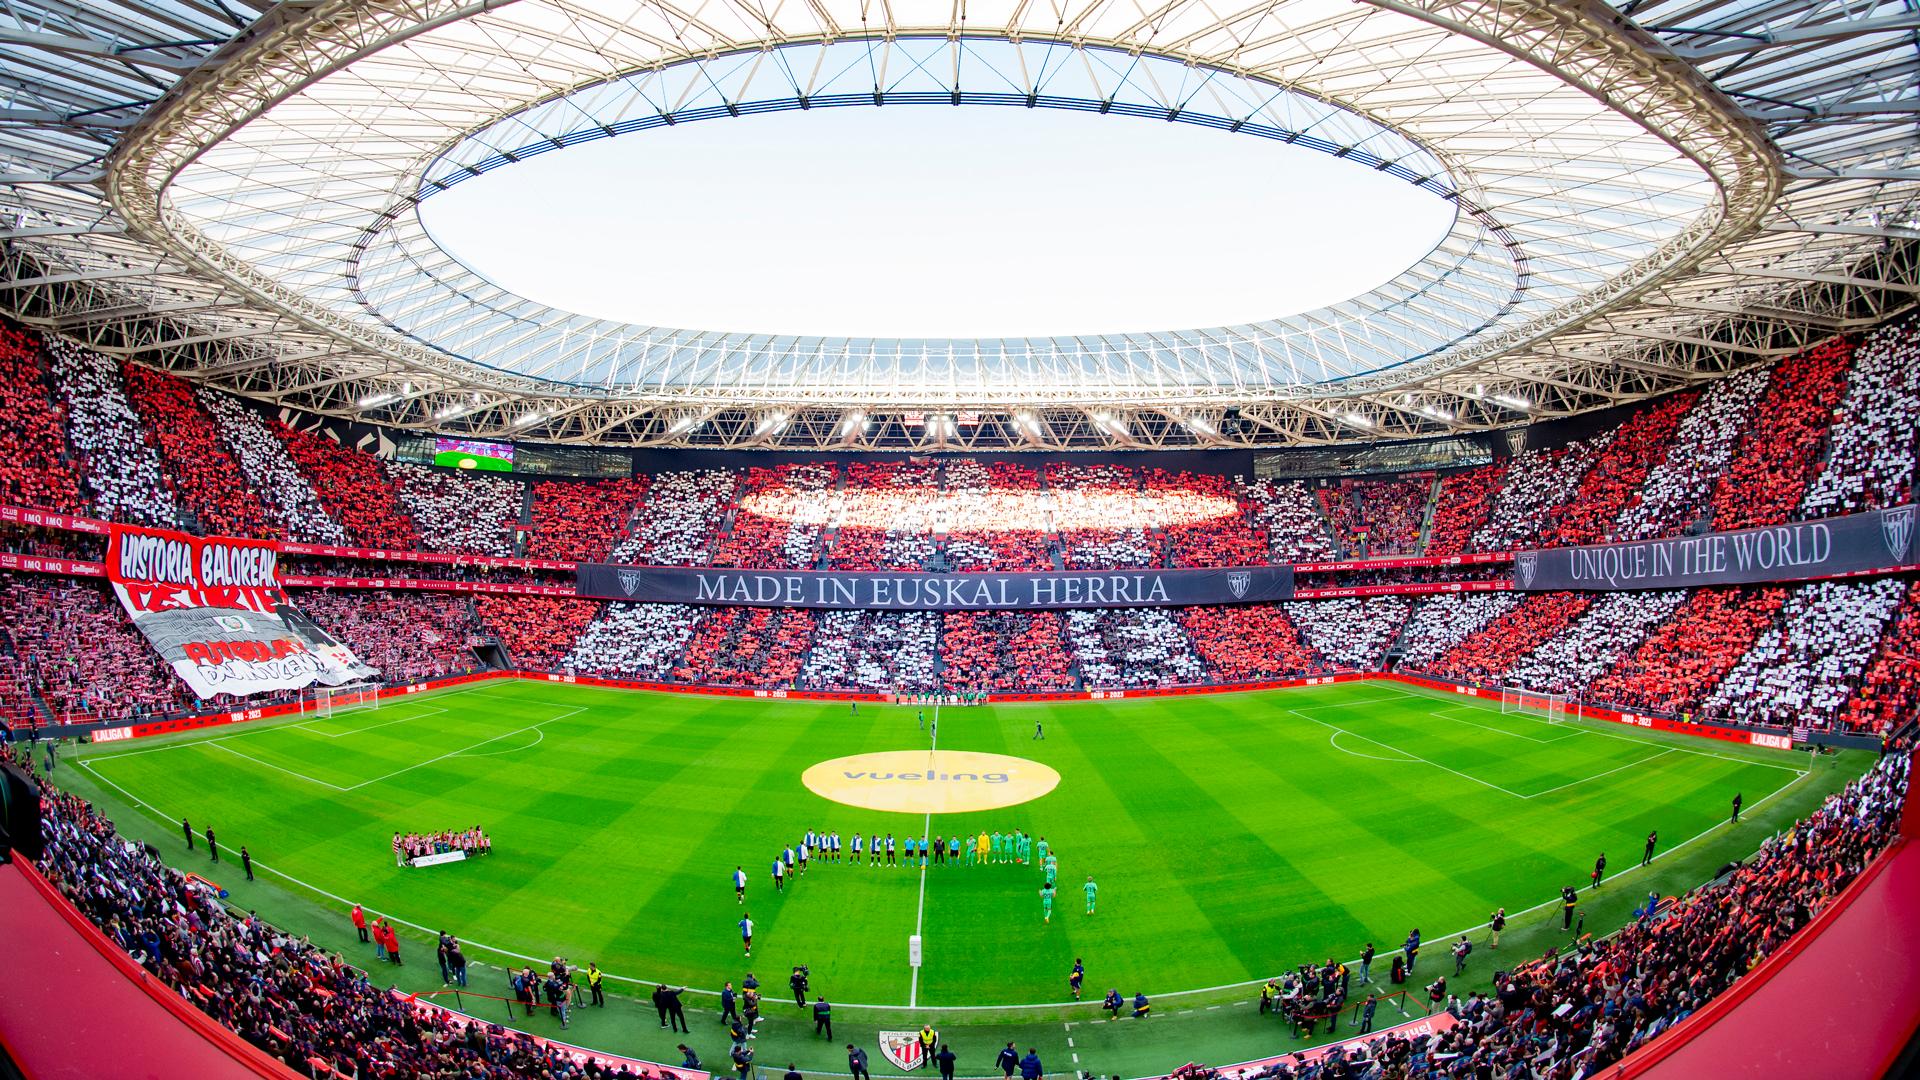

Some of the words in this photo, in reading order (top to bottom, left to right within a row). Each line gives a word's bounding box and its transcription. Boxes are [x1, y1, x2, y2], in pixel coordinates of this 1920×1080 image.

[24, 513, 41, 525] IMQ
[46, 516, 62, 528] IMQ
[1569, 545, 1647, 587] UNIQUE
[1651, 541, 1675, 577] IN
[1680, 536, 1727, 575] THE
[1732, 522, 1831, 572] WORLD
[24, 560, 41, 572] IMQ
[121, 532, 198, 590] HISTORIA,
[201, 544, 281, 590] BALOREAK,
[45, 562, 62, 573] IMQ
[696, 574, 805, 604] MADE
[816, 577, 857, 605] IN
[869, 577, 1019, 606] EUSKAL
[1029, 575, 1171, 605] HERRIA
[248, 710, 262, 719] 2023
[1638, 716, 1652, 727] 2023
[95, 731, 123, 742] LALIGA
[1752, 732, 1780, 748] LALIGA
[843, 769, 1010, 784] vueling
